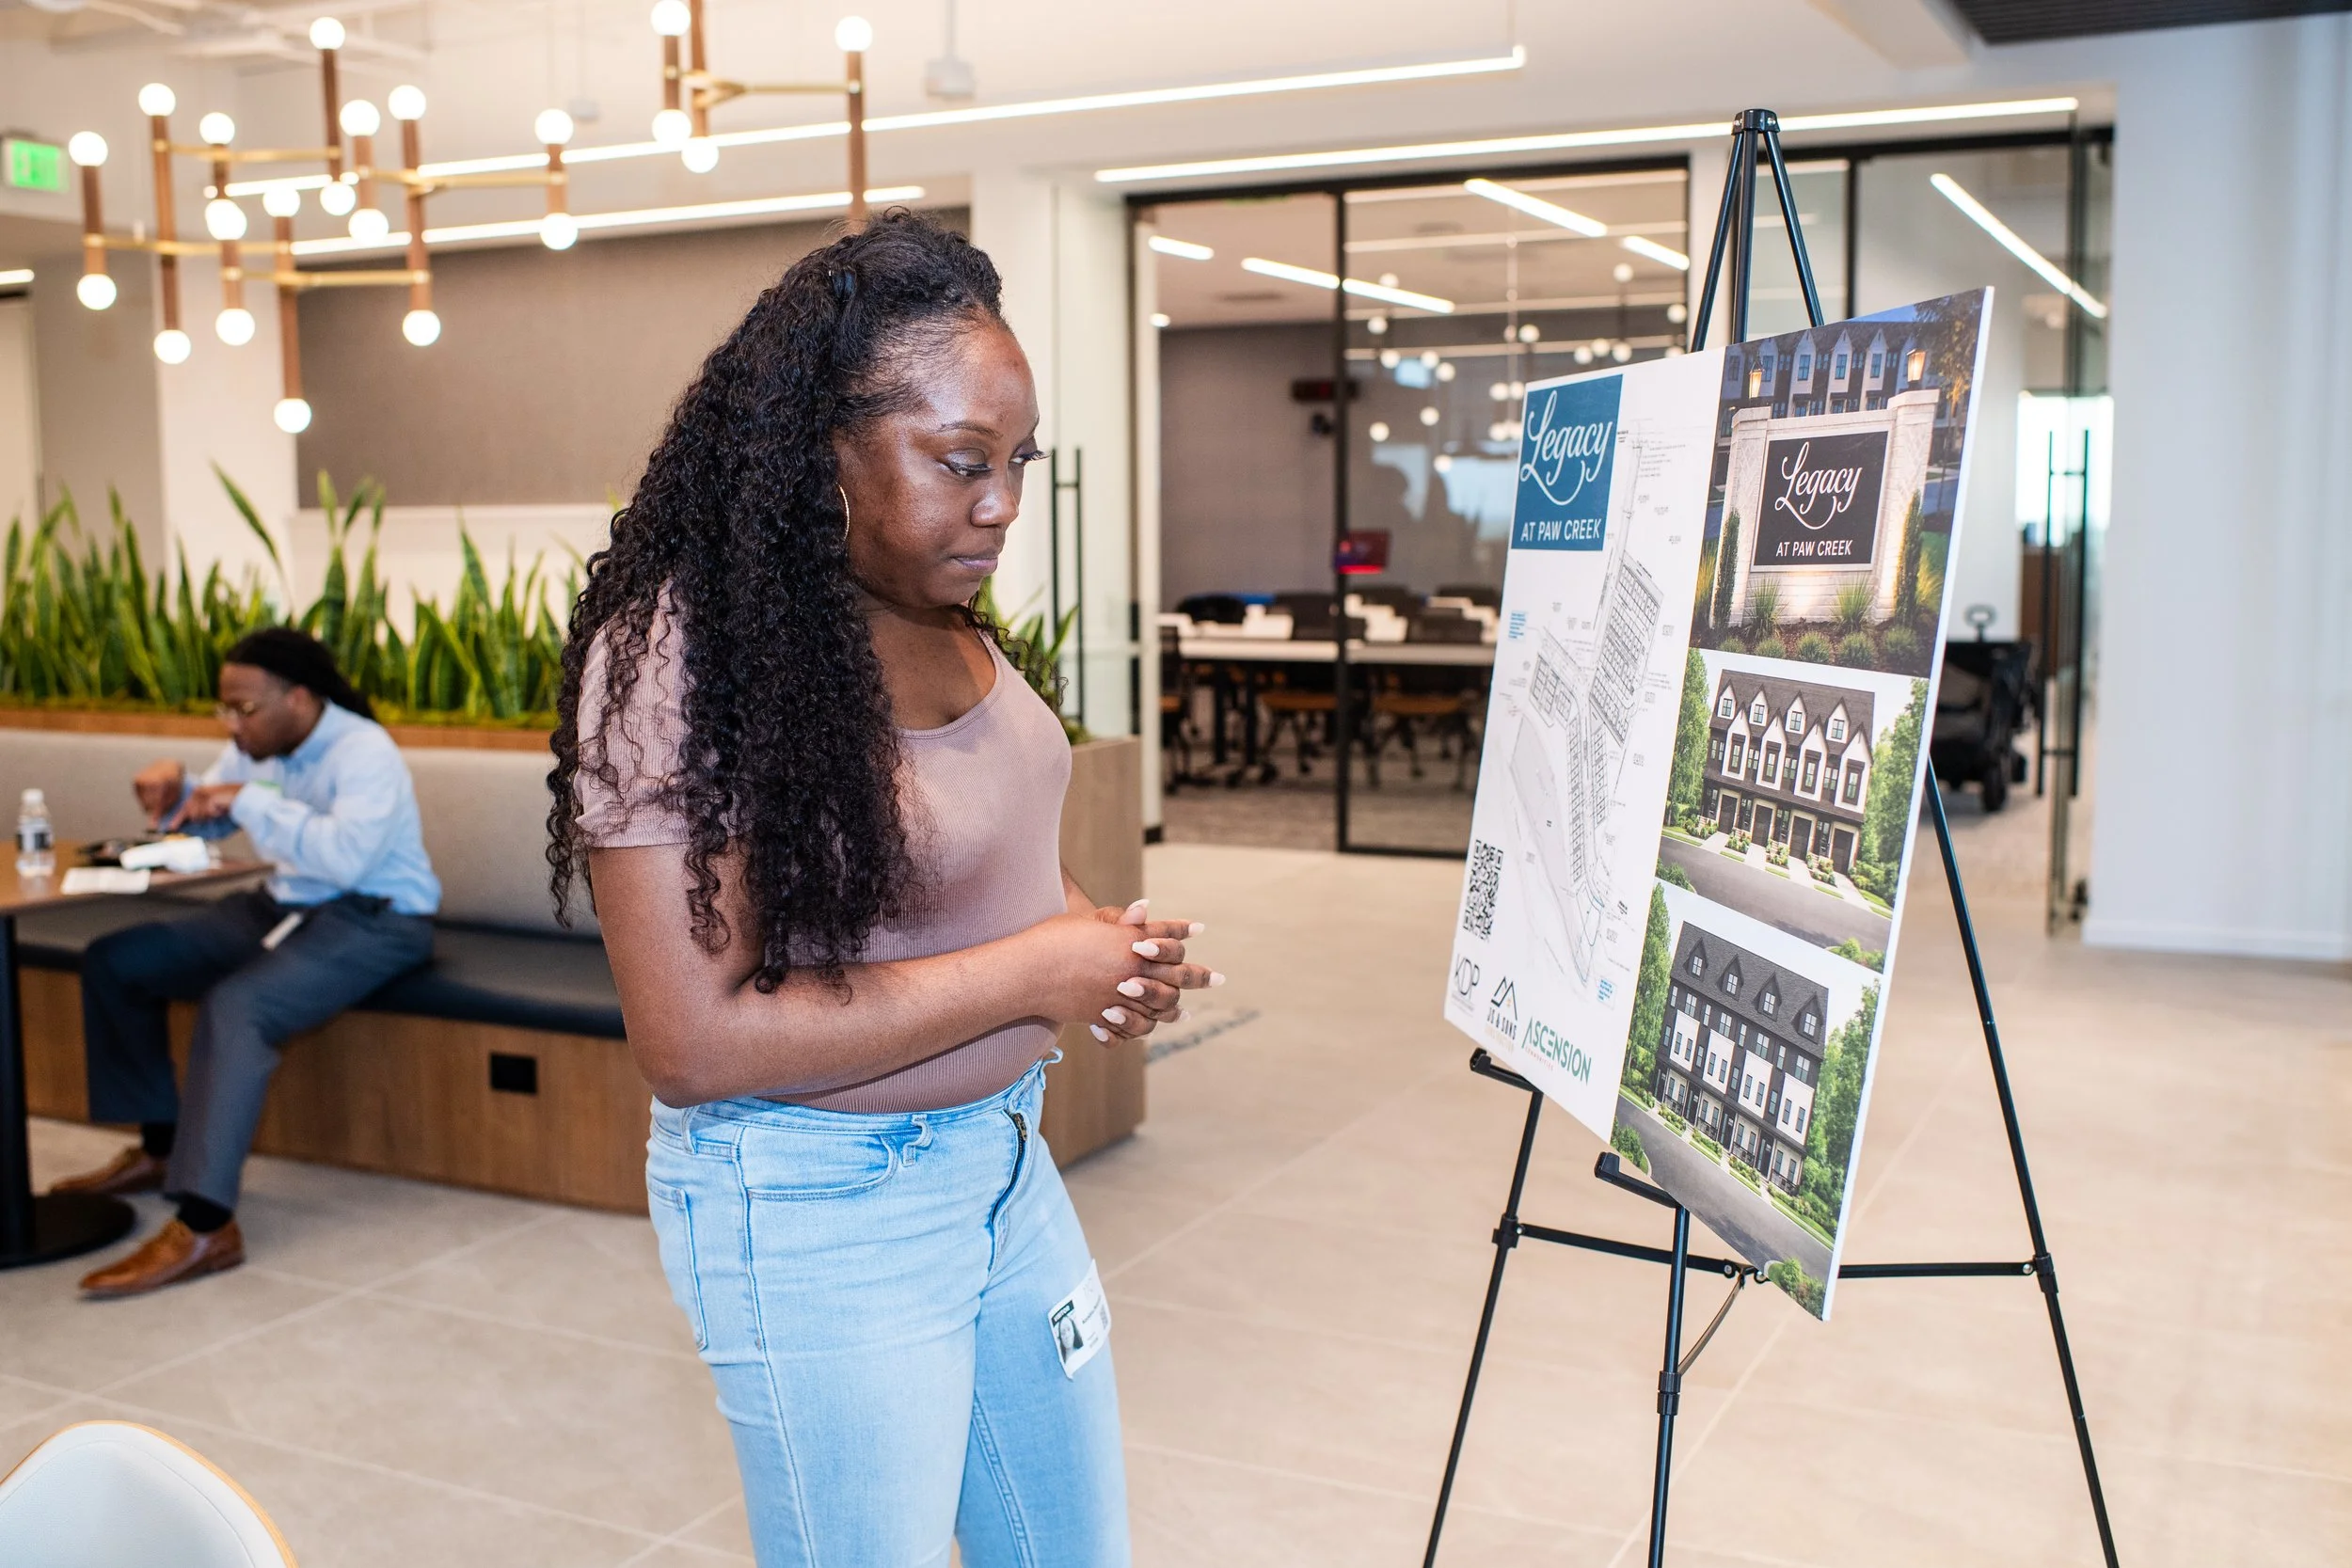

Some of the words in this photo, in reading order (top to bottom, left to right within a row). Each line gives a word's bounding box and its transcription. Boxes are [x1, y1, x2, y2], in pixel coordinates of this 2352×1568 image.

[1520, 389, 1613, 506] Legacy
[1774, 441, 1863, 530] Legacy
[1520, 521, 1536, 542] AT
[1537, 520, 1562, 541] PAW
[1564, 518, 1602, 540] CREEK
[1775, 542, 1789, 557] AT
[1792, 541, 1815, 556] PAW
[1817, 540, 1853, 556] CREEK
[1502, 1017, 1517, 1040] SONS
[1521, 1016, 1592, 1086] ASCENSION
